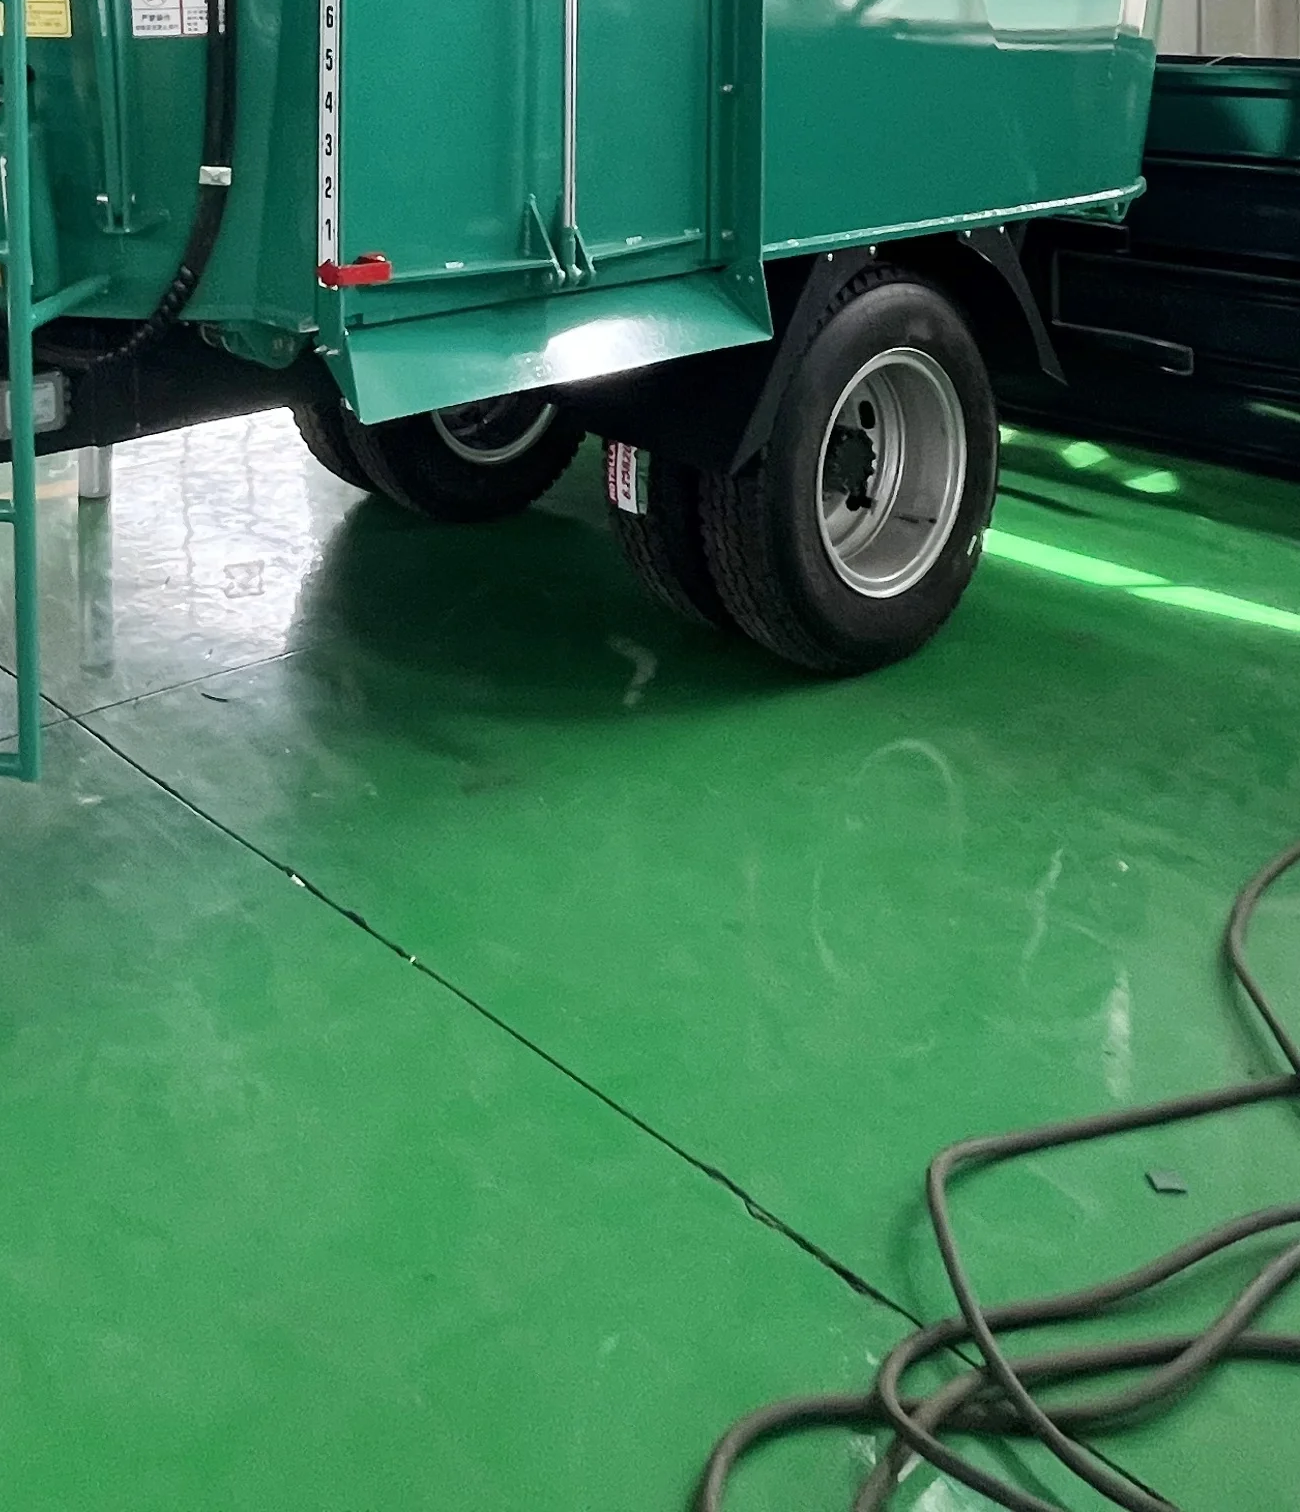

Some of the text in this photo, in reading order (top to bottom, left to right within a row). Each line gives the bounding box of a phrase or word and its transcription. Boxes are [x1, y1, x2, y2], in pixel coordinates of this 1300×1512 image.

[326, 5, 334, 28] 6
[325, 48, 333, 71] 5
[325, 91, 333, 113] 4
[325, 133, 332, 156] 3
[325, 176, 332, 199] 2
[325, 218, 332, 240] 1
